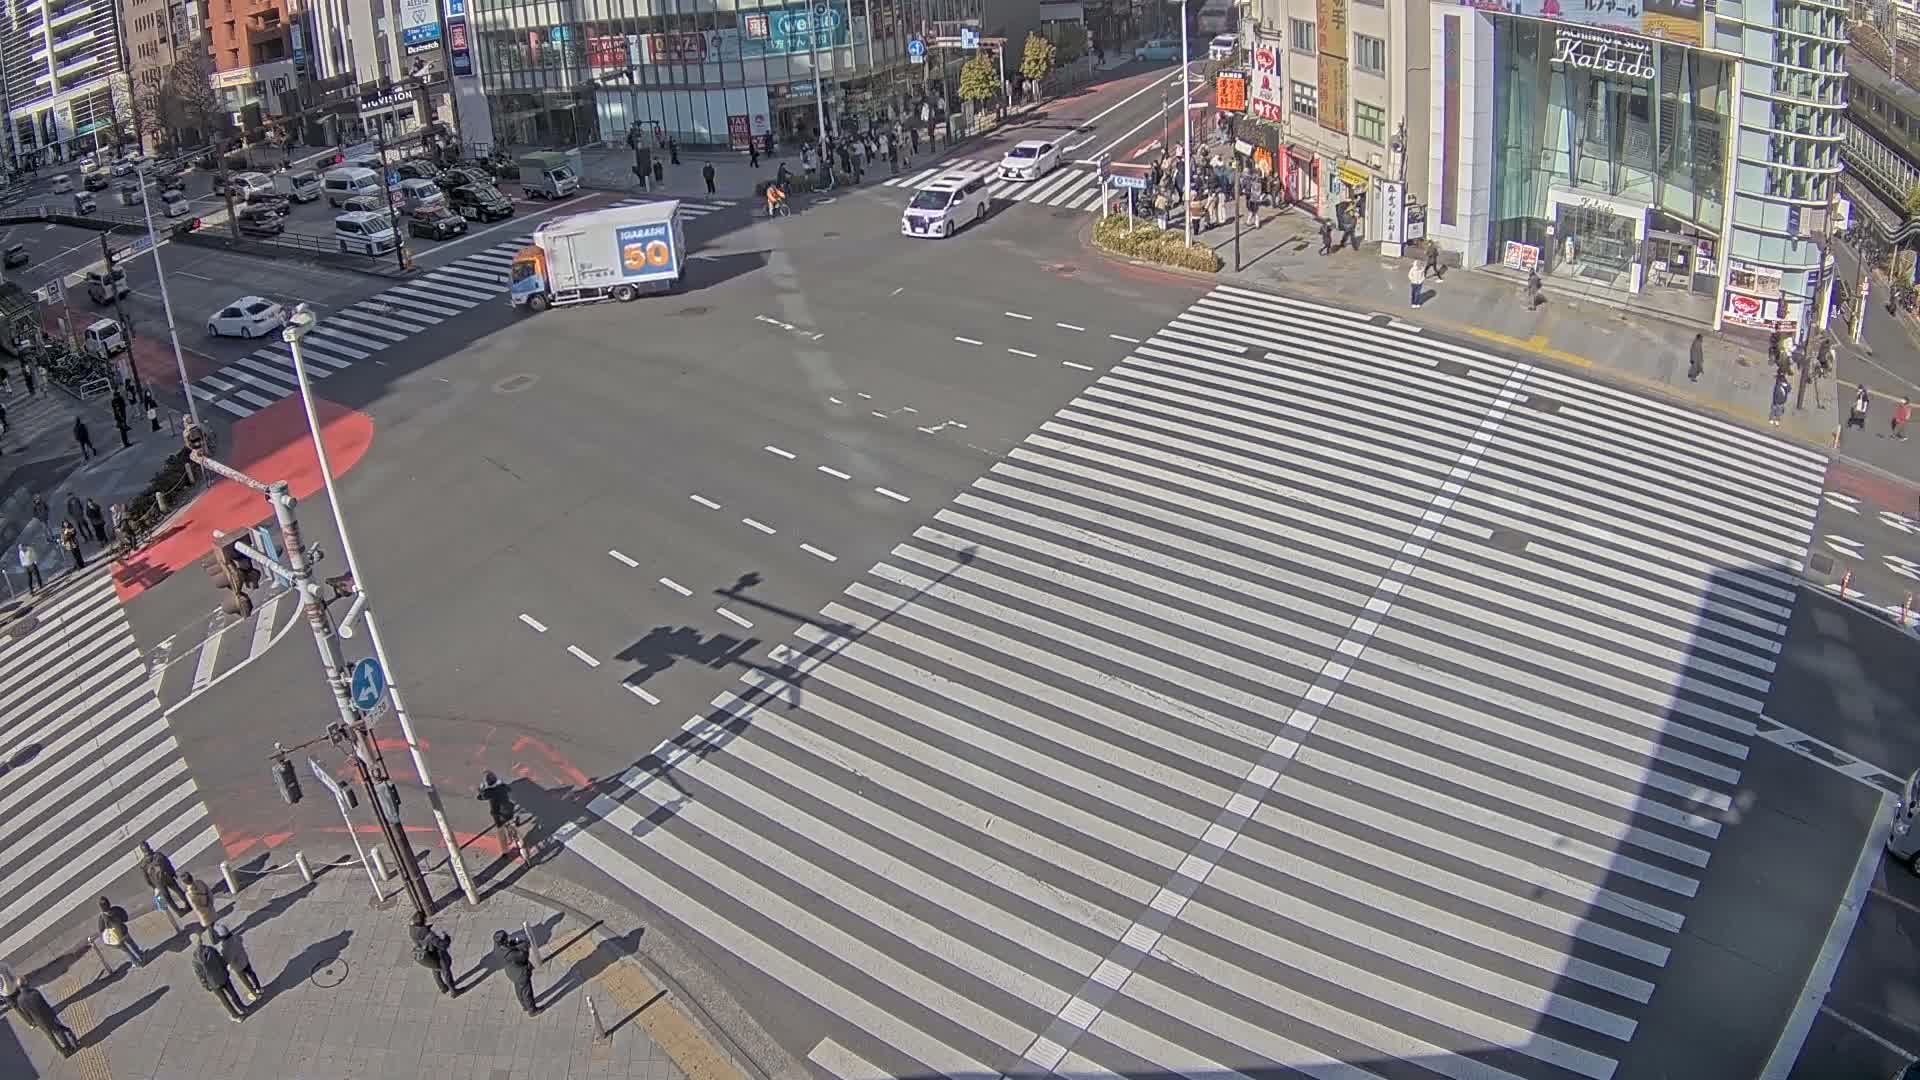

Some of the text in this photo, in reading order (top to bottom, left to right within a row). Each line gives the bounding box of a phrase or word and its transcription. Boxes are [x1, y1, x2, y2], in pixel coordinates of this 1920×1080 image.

[1549, 37, 1656, 80] Kaleido
[620, 226, 665, 241] IGARASHI
[623, 239, 670, 271] 50
